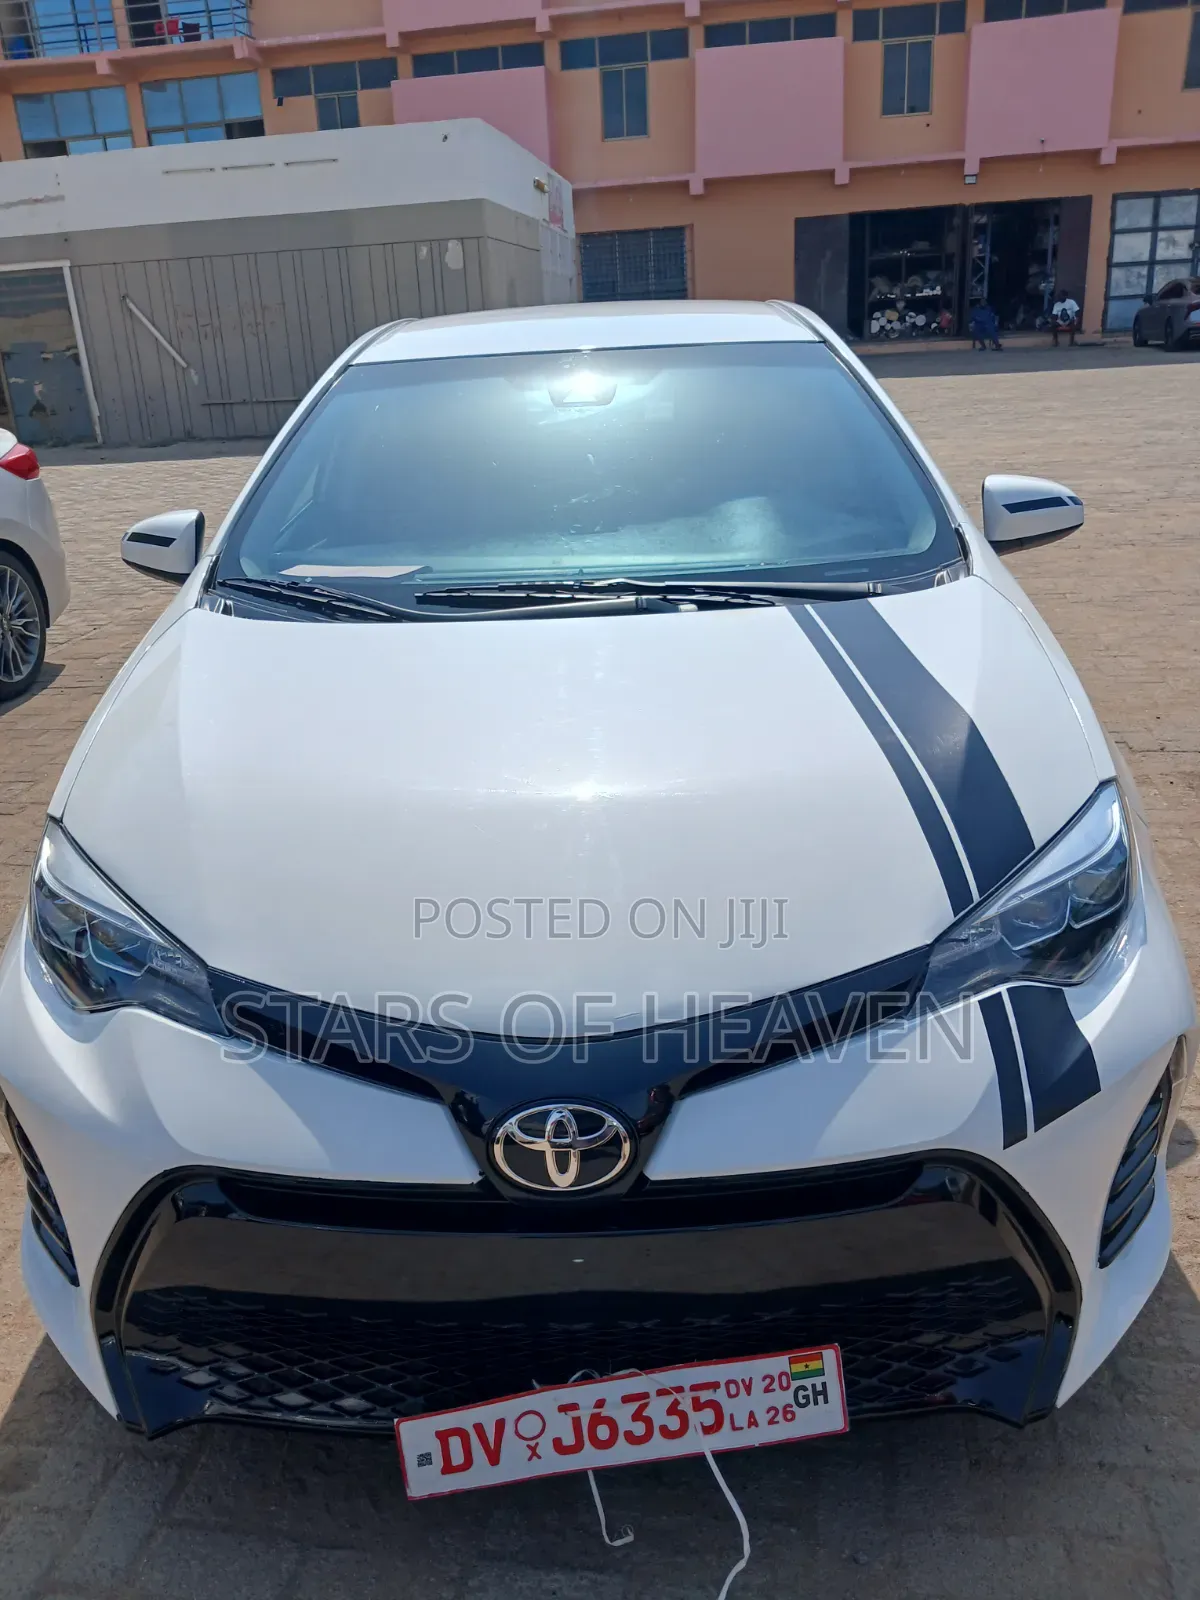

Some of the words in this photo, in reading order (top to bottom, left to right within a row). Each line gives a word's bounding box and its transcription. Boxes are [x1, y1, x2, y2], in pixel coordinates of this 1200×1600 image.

[724, 1377, 753, 1398] DV
[761, 1371, 792, 1393] 20
[793, 1381, 829, 1409] GH
[434, 1417, 506, 1475] DV
[552, 1381, 724, 1456] J6335
[730, 1410, 759, 1431] LA
[766, 1403, 796, 1425] 26
